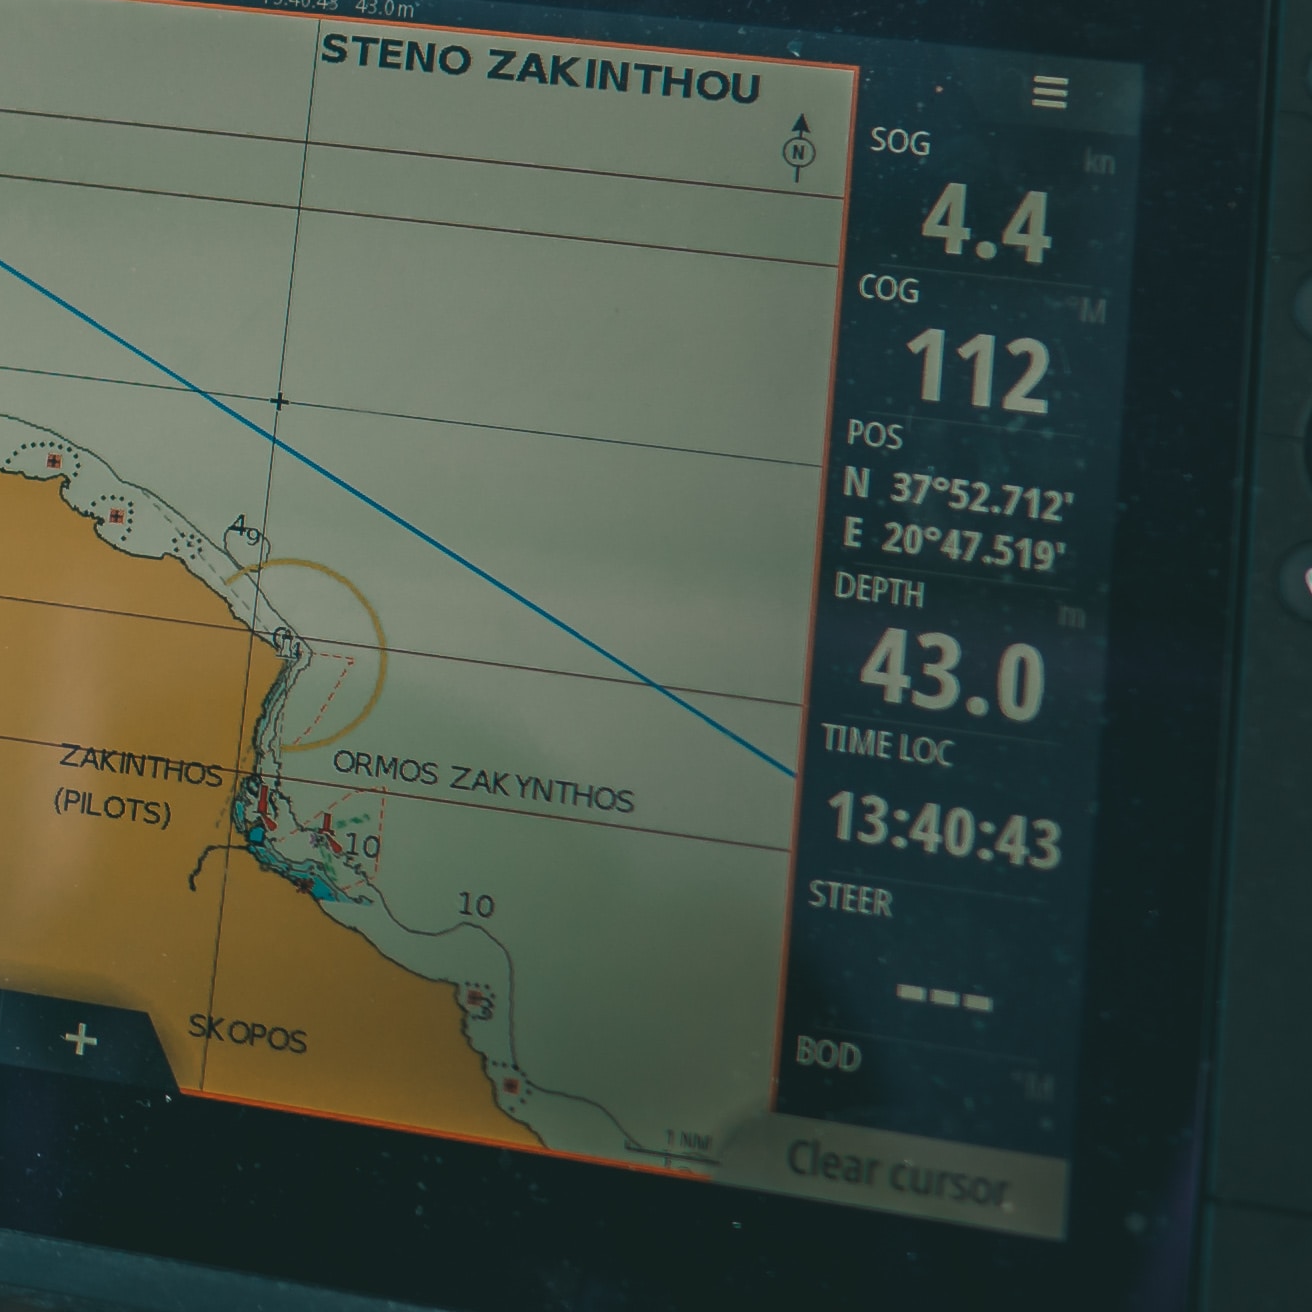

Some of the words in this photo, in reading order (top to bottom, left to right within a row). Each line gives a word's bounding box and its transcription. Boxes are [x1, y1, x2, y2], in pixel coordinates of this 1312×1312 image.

[321, 33, 471, 76] STENO
[487, 48, 761, 104] ZAKINTHOU
[870, 127, 931, 156] SOG
[1084, 148, 1116, 175] kn
[922, 183, 1052, 264] 4.4
[859, 274, 920, 304] COG
[906, 328, 1050, 414] 112
[847, 419, 904, 450] POS
[843, 466, 870, 498] N
[844, 516, 863, 548] E
[835, 571, 925, 608] DEPTH
[860, 627, 1045, 722] 43.0
[59, 743, 224, 787] ZAKINTHOS
[821, 723, 893, 759] TIME
[899, 733, 956, 767] LOC
[333, 749, 439, 786] ORMOS
[450, 765, 635, 814] ZAKYNTHOS
[53, 787, 172, 829] (PILOTS)
[344, 832, 381, 860] 10
[827, 791, 1063, 870] 13:40:43
[457, 891, 495, 918] 10
[808, 880, 894, 918] STEER
[187, 1013, 308, 1055] SKOPOS
[796, 1036, 862, 1072] BOD
[787, 1139, 879, 1186] Clear
[889, 1160, 1012, 1209] cursor
